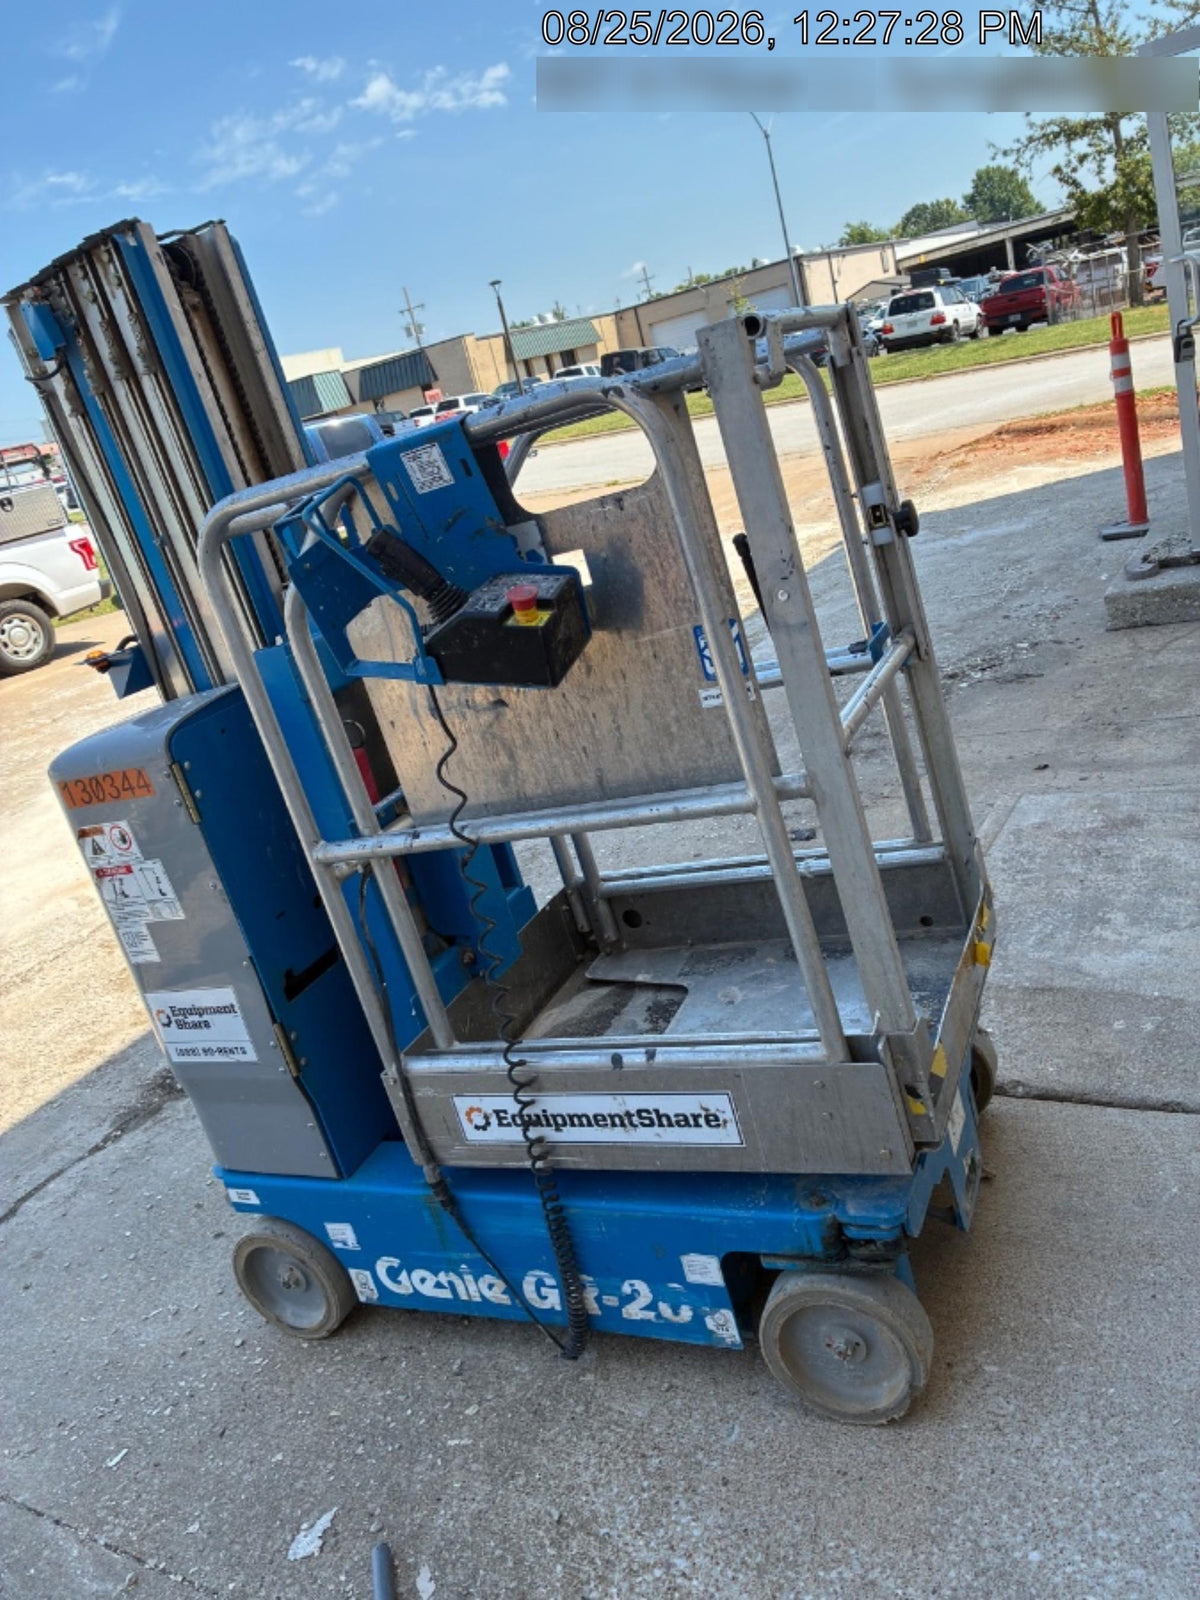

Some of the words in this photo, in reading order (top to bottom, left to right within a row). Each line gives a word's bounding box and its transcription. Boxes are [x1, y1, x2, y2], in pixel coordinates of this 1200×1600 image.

[63, 770, 152, 807] 130344
[168, 1003, 238, 1019] Equipment
[174, 1019, 212, 1030] Share
[375, 1256, 513, 1306] Genie
